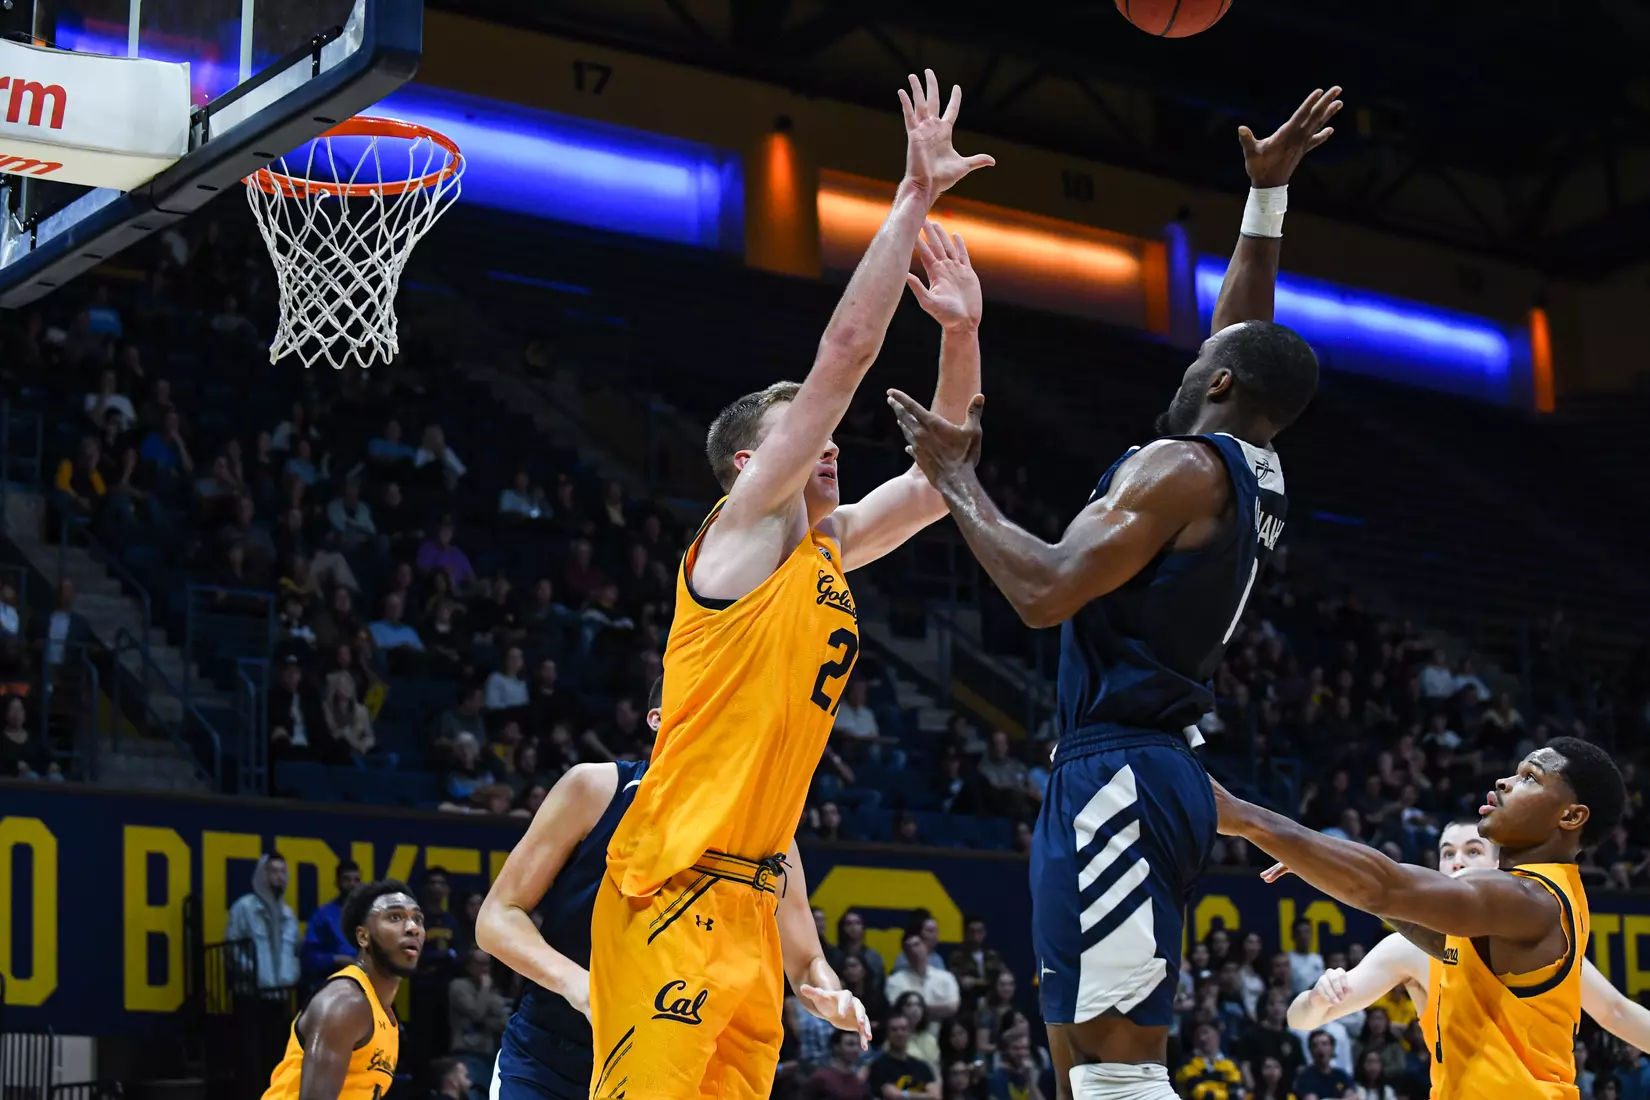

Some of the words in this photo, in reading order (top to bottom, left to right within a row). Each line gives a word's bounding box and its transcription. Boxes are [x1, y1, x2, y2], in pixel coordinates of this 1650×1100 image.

[573, 59, 612, 95] 17
[0, 154, 64, 175] m
[810, 627, 858, 717] 2
[651, 979, 708, 1026] Cal
